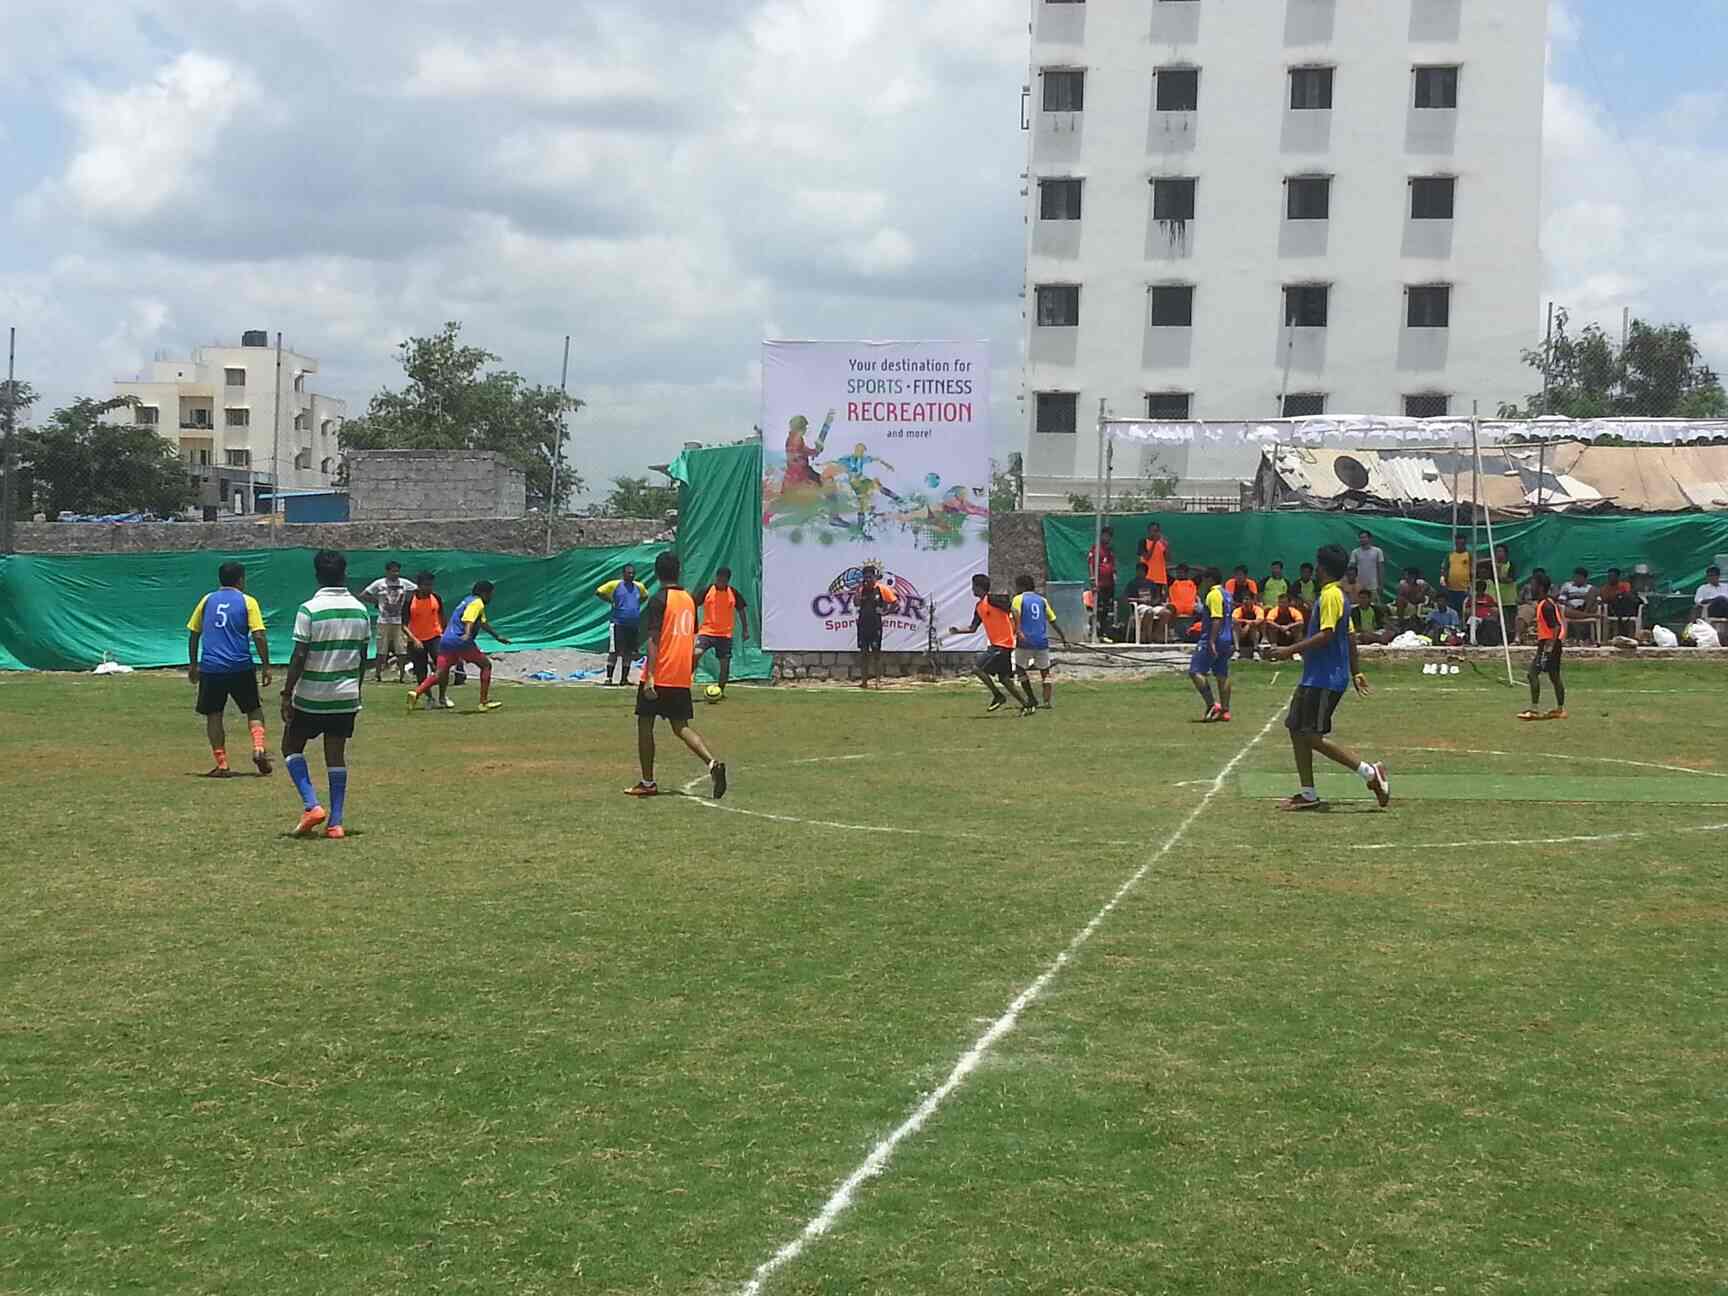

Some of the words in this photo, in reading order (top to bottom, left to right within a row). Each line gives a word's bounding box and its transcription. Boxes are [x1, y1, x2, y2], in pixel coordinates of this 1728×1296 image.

[848, 359, 877, 372] Your
[880, 358, 950, 372] destination
[954, 358, 972, 372] for
[847, 379, 903, 394] SPORTS
[913, 379, 972, 394] FITNESS
[847, 401, 972, 422] RECREATION
[887, 428, 904, 438] and
[906, 428, 932, 438] more!
[812, 592, 926, 620] CYR
[1031, 602, 1040, 620] 9
[215, 602, 231, 628] 5
[880, 619, 917, 633] entre
